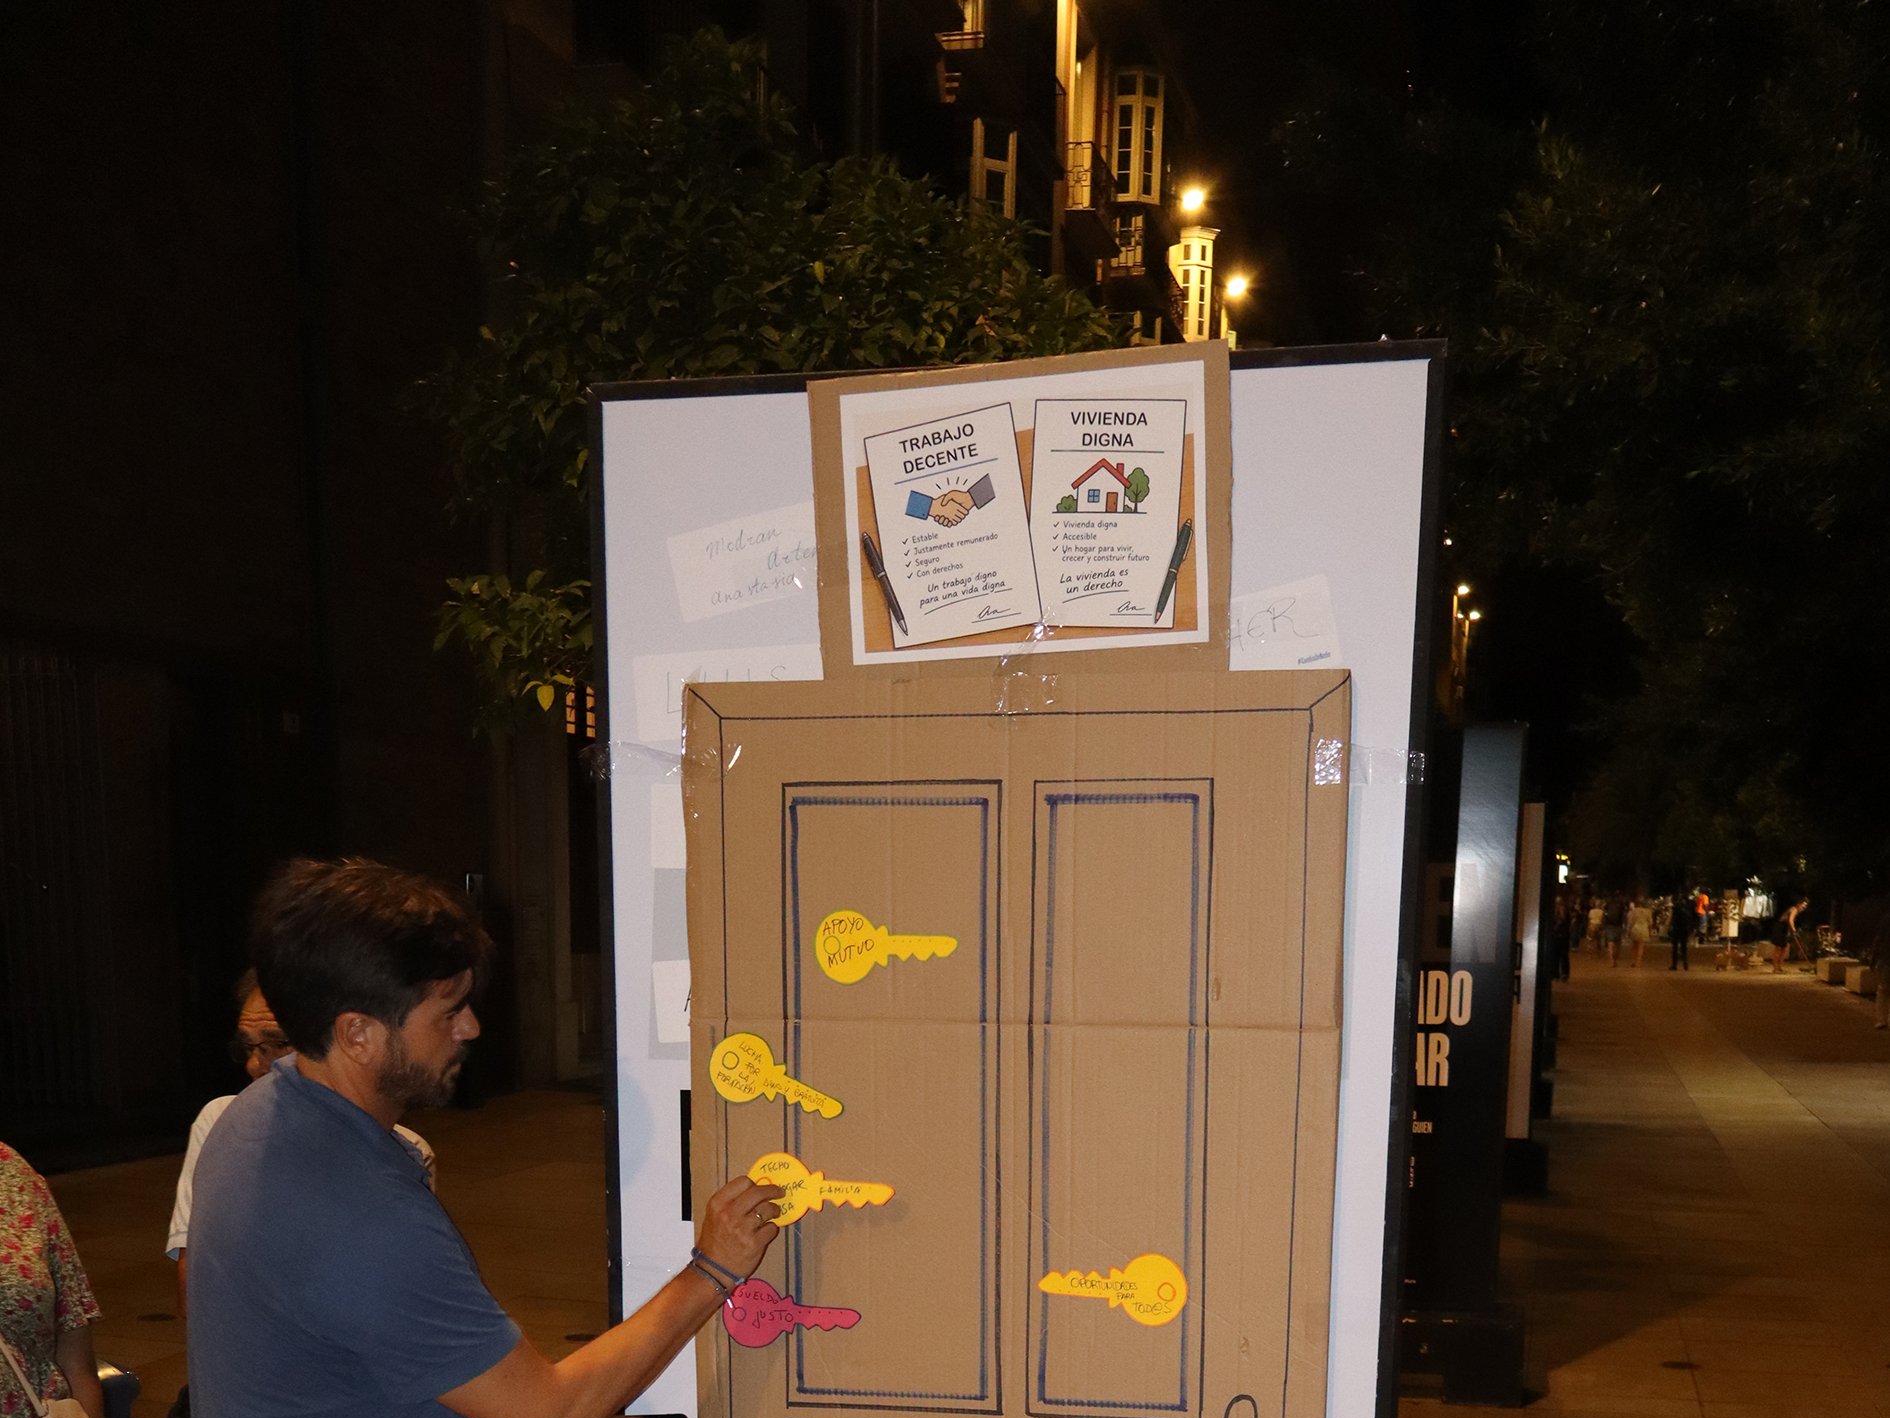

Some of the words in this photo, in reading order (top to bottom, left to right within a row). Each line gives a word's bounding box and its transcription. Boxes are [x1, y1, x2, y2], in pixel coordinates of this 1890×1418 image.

[1071, 411, 1148, 426] VIVIENDA
[899, 423, 974, 453] TRABAJO
[1082, 433, 1134, 447] DIGNA
[903, 443, 978, 474] DECENTE
[1063, 520, 1095, 528] Vivienda
[1097, 520, 1118, 531] digna
[911, 532, 939, 544] Estable
[913, 541, 955, 556] Justamente
[956, 532, 999, 547] remunerado
[1062, 532, 1097, 541] Accesible
[1062, 545, 1073, 554] Un
[1074, 545, 1095, 555] hogar
[1097, 546, 1115, 555] para
[1116, 545, 1135, 554] vivir,
[915, 556, 940, 568] Seguro
[1086, 555, 1091, 564] y
[1093, 554, 1126, 562] construir
[1127, 553, 1150, 562] futuro
[916, 569, 931, 578] Con
[932, 562, 964, 575] derechos
[1060, 573, 1072, 584] La
[1076, 568, 1116, 582] vivienda
[1119, 568, 1129, 577] es
[927, 584, 939, 593] Un
[942, 576, 972, 590] trabajo
[975, 570, 998, 582] digno
[1066, 585, 1079, 594] un
[1083, 579, 1124, 592] derecho
[919, 596, 939, 609] para
[942, 591, 958, 600] una
[961, 585, 979, 596] vida
[982, 580, 1006, 592] digna
[822, 916, 864, 936] APOYO
[827, 938, 875, 968] MUTUO
[744, 1062, 761, 1077] POR
[760, 1160, 790, 1172] TECHO
[778, 1179, 808, 1198] OGAR
[819, 1185, 863, 1196] FAMILIA
[738, 1287, 779, 1305] SUELDO
[752, 1309, 794, 1329] JUSTO
